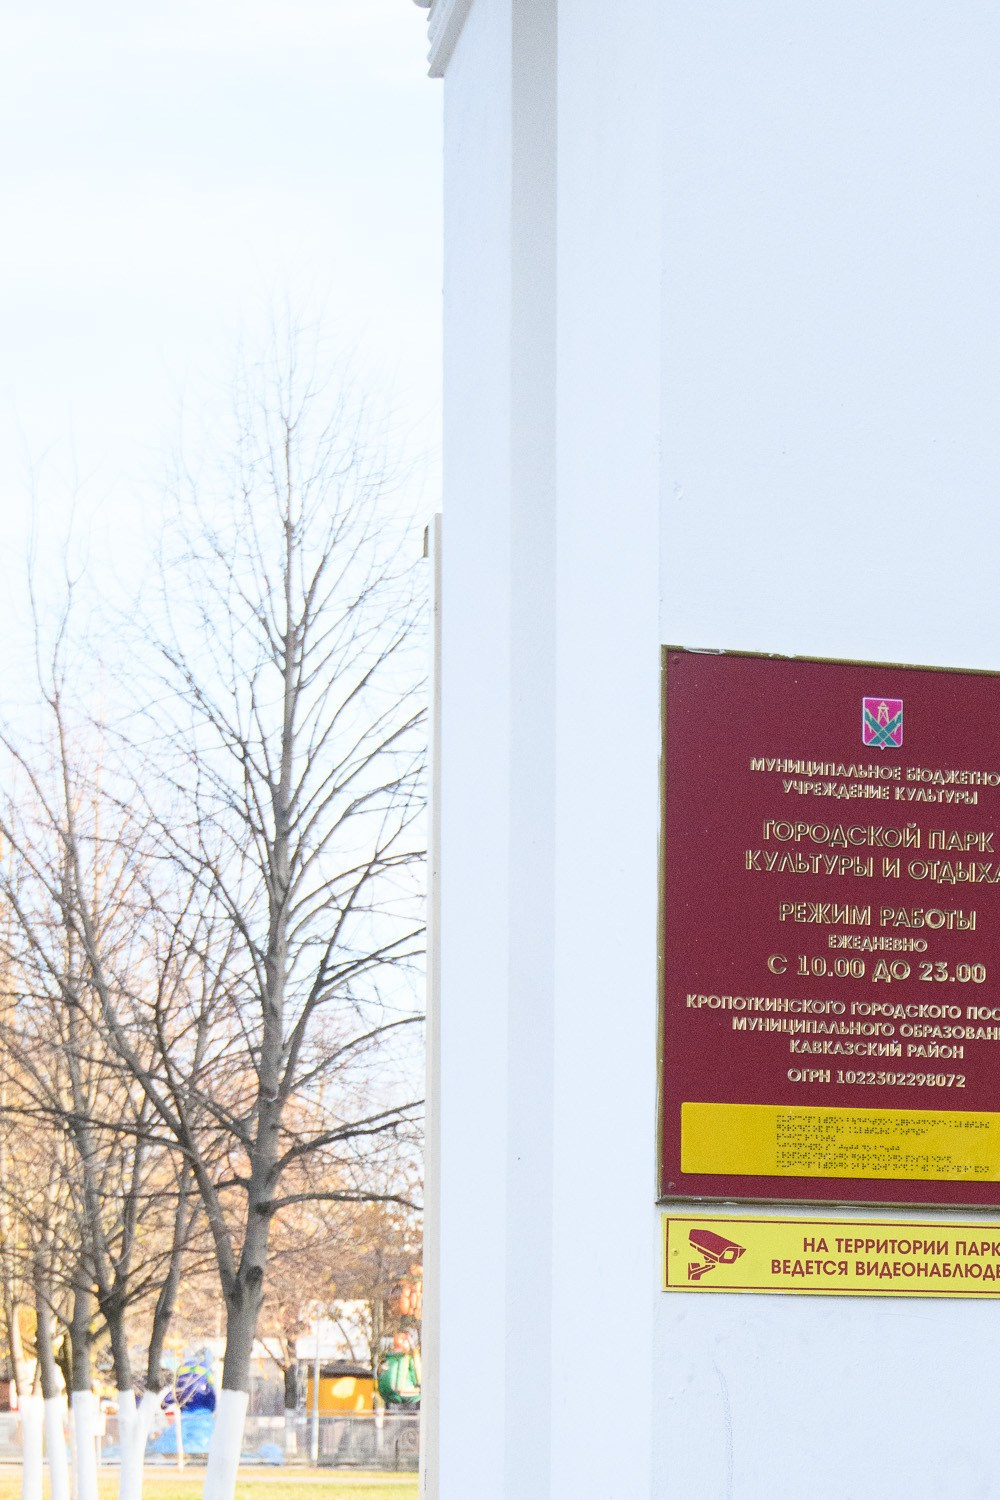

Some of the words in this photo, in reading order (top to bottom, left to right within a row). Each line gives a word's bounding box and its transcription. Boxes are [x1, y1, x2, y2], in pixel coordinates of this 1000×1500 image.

[750, 757, 901, 780] МУНИЦИПАЛЬНОЕ
[782, 779, 890, 800] УЧРЕЖДЕНИЕ
[895, 786, 978, 805] КУЛЬТУРЫ
[763, 820, 921, 848] ГОРОДСКОЙ
[929, 830, 995, 853] ПАРК
[745, 850, 874, 878] КУЛЬТУРЫ
[883, 857, 900, 878] И
[778, 901, 871, 926] РЕЖИМ
[880, 906, 977, 931] РАБОТЫ
[828, 934, 928, 953] ЕЖЕДНЕВНО
[767, 954, 787, 975] С
[797, 954, 866, 979] 10.00
[871, 959, 911, 983] ДО
[918, 961, 987, 984] 23.00
[686, 994, 845, 1015] КРОПОТКИНСКОГО
[850, 1001, 962, 1019] ГОРОДСКОГО
[732, 1016, 895, 1037] МУНИЦИПАЛЬНОГО
[789, 1038, 902, 1058] КАВКАЗСКИЙ
[906, 1041, 964, 1060] РАЙОН
[787, 1068, 831, 1084] ОГРН
[836, 1069, 966, 1088] 1022302298072
[803, 1237, 827, 1254] НА
[835, 1238, 949, 1257] ТЕРРИТОРИИ
[771, 1259, 848, 1279] ВЕДЕТСЯ
